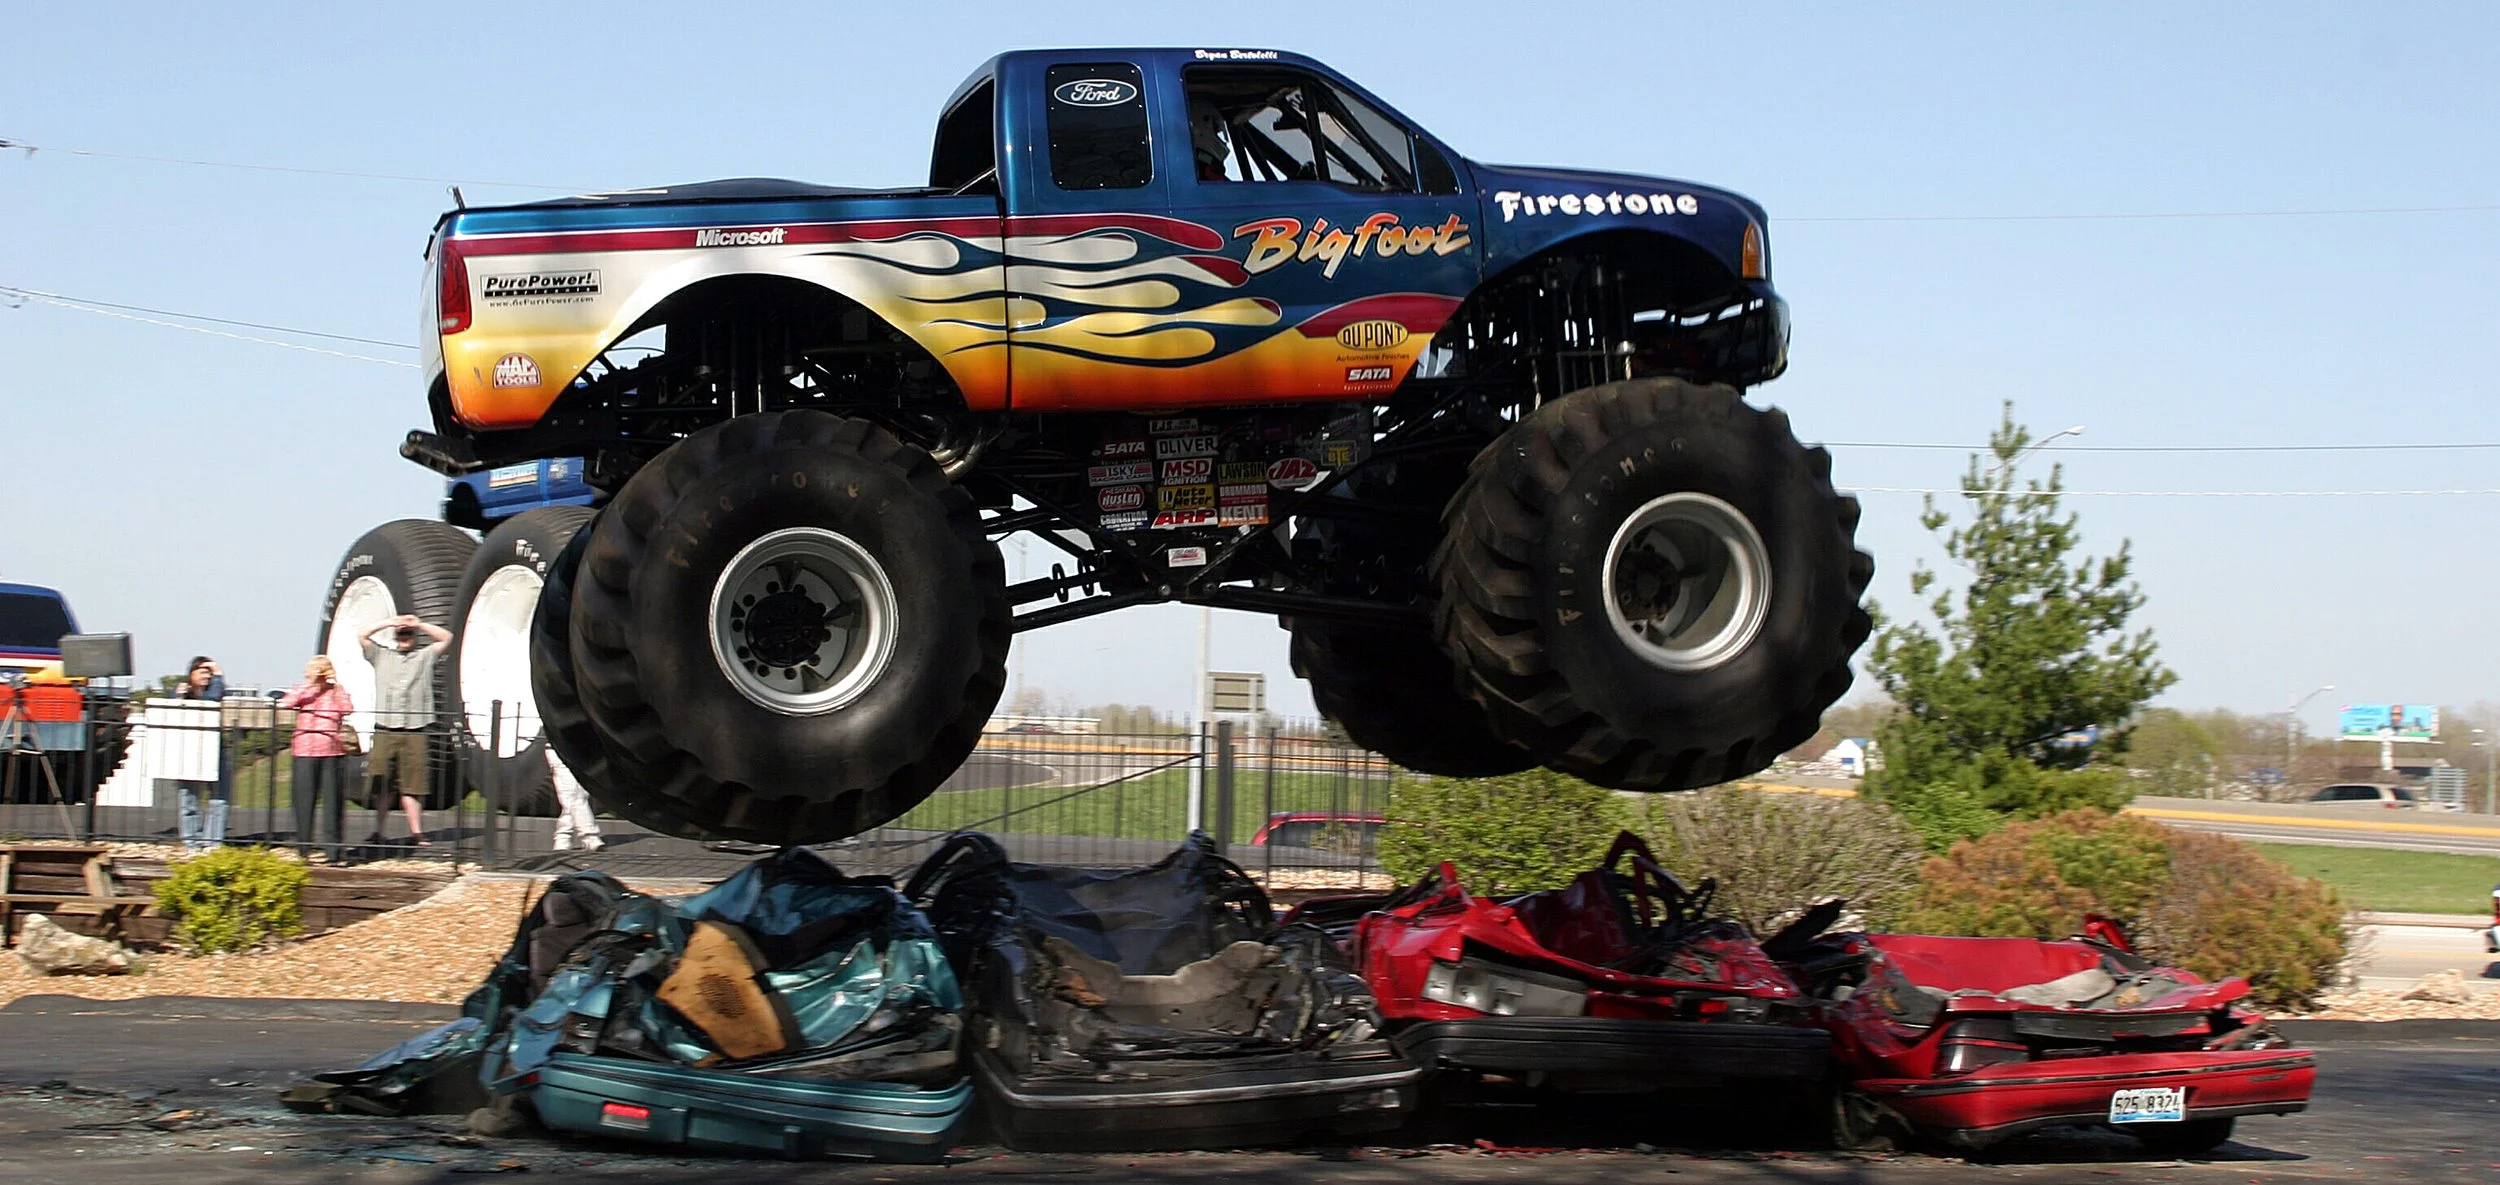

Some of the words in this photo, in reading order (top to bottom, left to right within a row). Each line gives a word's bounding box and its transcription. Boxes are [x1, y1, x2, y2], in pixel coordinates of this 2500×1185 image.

[1070, 81, 1121, 101] Ford
[1495, 191, 1699, 222] Firestone
[695, 227, 785, 248] Microsoft
[1234, 212, 1474, 281] Bigfoot
[486, 272, 593, 289] PurePower!
[1365, 322, 1403, 347] PONT
[1348, 368, 1391, 381] SATA
[1104, 441, 1146, 455] SATA
[1159, 437, 1218, 454] OLIVER
[1108, 465, 1135, 477] ISKY
[1164, 460, 1209, 477] MSD
[1219, 463, 1266, 479] LAWSON
[1164, 475, 1208, 486] IGNITION
[1176, 487, 1206, 497] Auto
[1154, 509, 1216, 526] ARP
[1220, 506, 1265, 520] KENT
